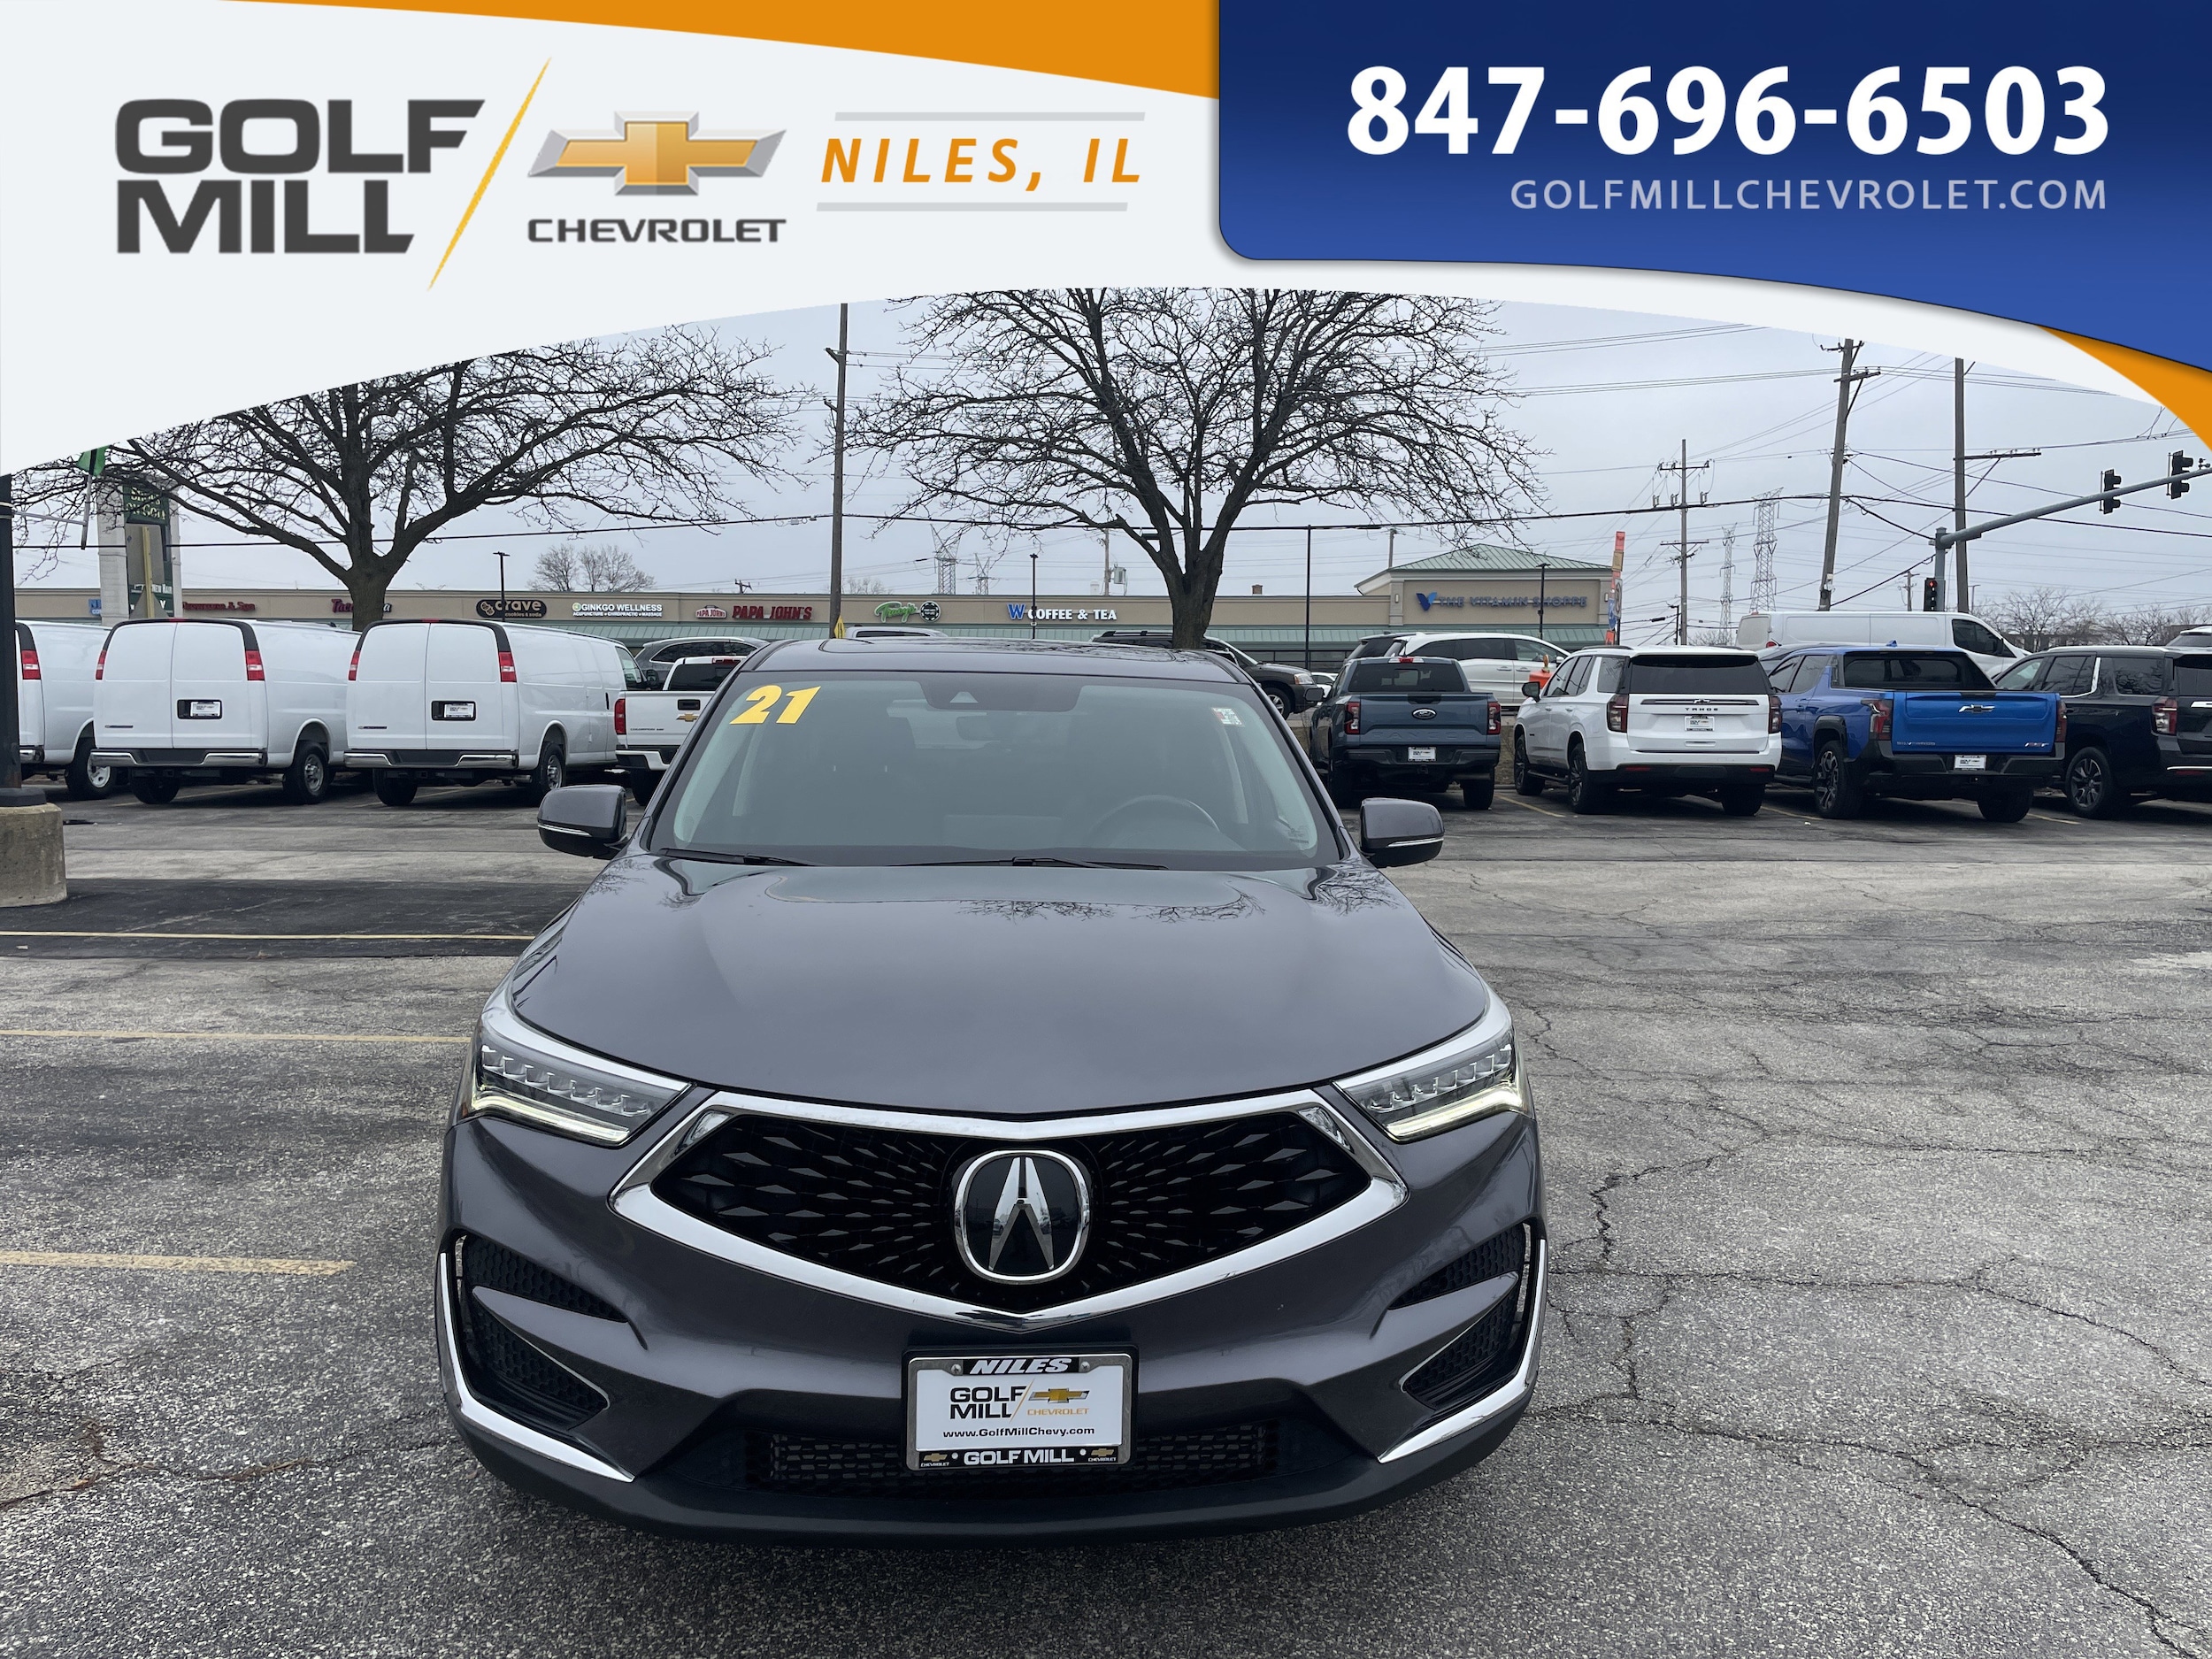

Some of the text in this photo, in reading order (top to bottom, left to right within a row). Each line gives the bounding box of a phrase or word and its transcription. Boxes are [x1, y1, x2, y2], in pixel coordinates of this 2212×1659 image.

[1439, 596, 1465, 607] THE
[1469, 596, 1529, 607] VITAMIN
[732, 605, 813, 620] PAPA JOHN'S
[1027, 609, 1072, 620] COFFEE
[1077, 609, 1088, 620] &
[1093, 609, 1118, 620] TEA
[729, 684, 821, 725] 21
[969, 1357, 1072, 1375] NILES
[949, 1386, 1027, 1403] GOLF
[949, 1403, 1012, 1420] MILL
[1027, 1408, 1089, 1417] CHEVROLET
[942, 1426, 1095, 1438] www.GolfMillChevy.com
[964, 1448, 1075, 1465] GOLF MILL
